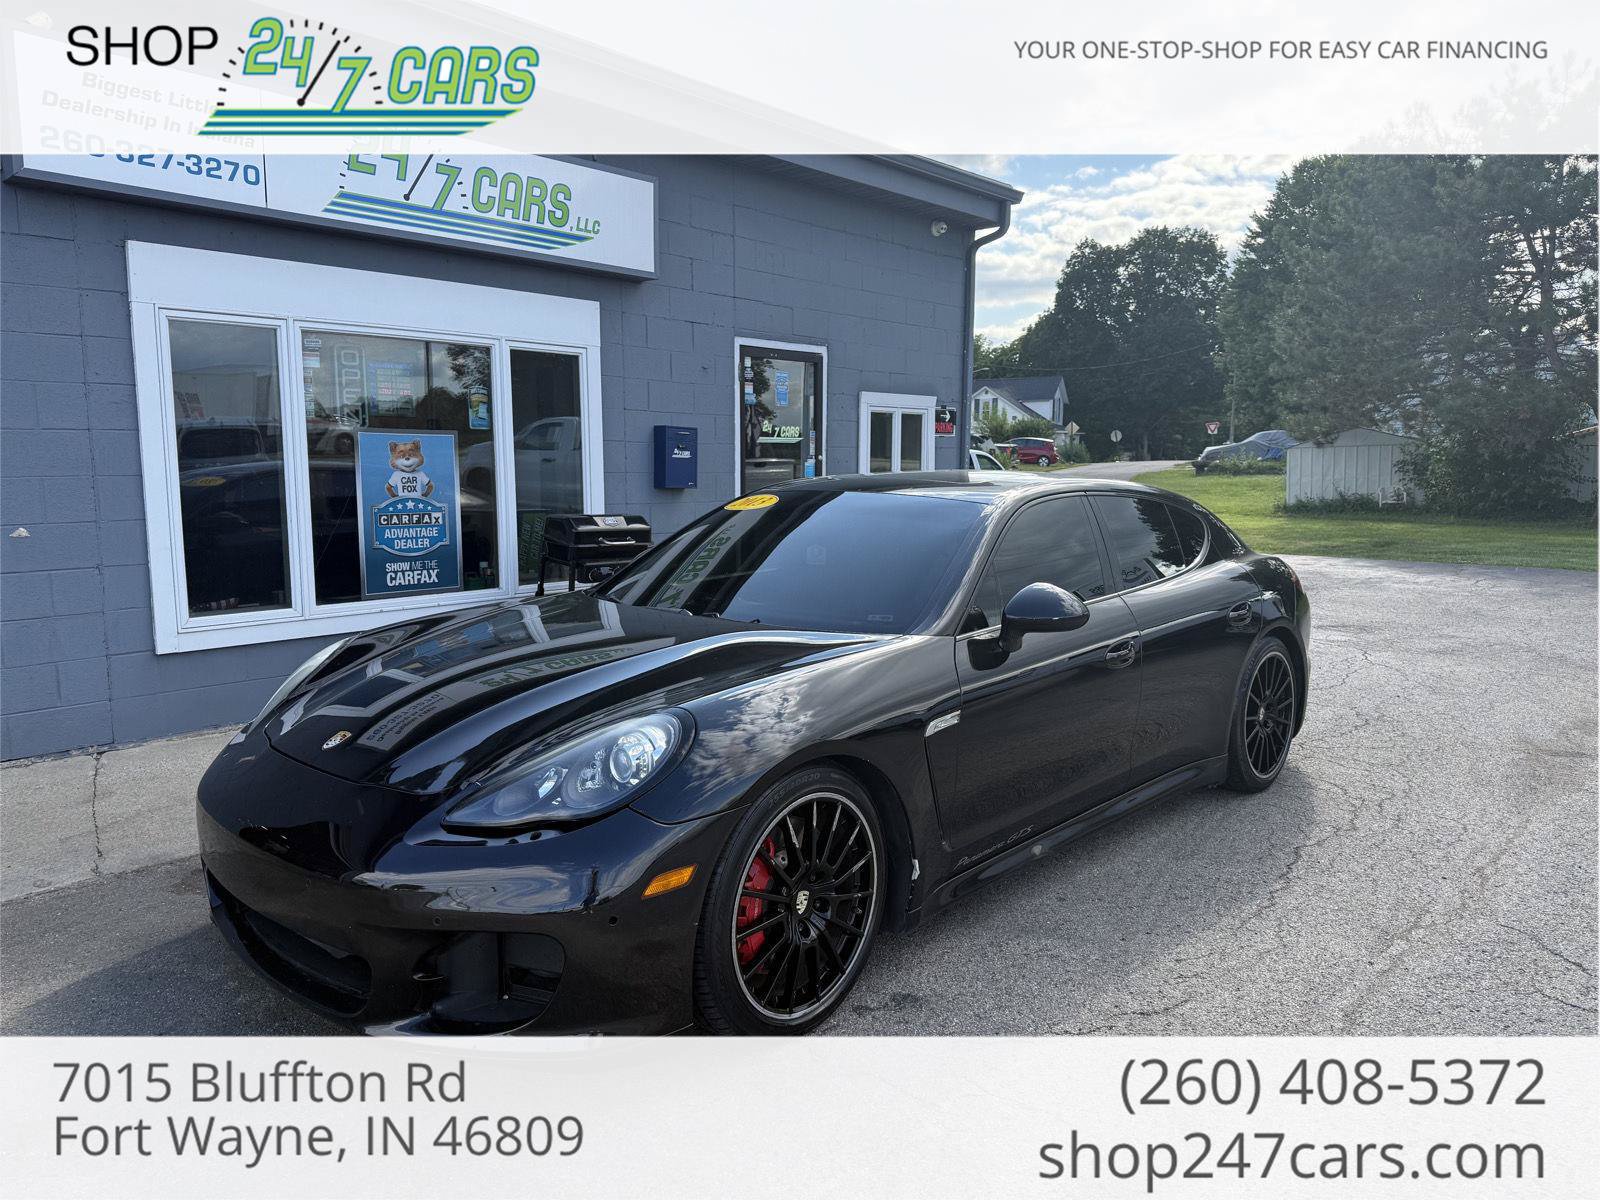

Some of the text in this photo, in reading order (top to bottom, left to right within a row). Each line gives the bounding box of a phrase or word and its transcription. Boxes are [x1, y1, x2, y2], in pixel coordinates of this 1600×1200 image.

[82, 71, 162, 103] Biggest
[41, 89, 157, 131] Dealership
[163, 115, 182, 133] In
[40, 124, 261, 187] 260-327-3270
[780, 426, 800, 438] CARS
[401, 476, 418, 485] CAR
[402, 485, 418, 493] FOX
[379, 513, 441, 526] CARFAX
[384, 527, 439, 539] ADVANTAGE
[394, 539, 430, 549] DEALER
[385, 560, 438, 572] SHOW ME THE
[386, 570, 439, 587] CARFAX
